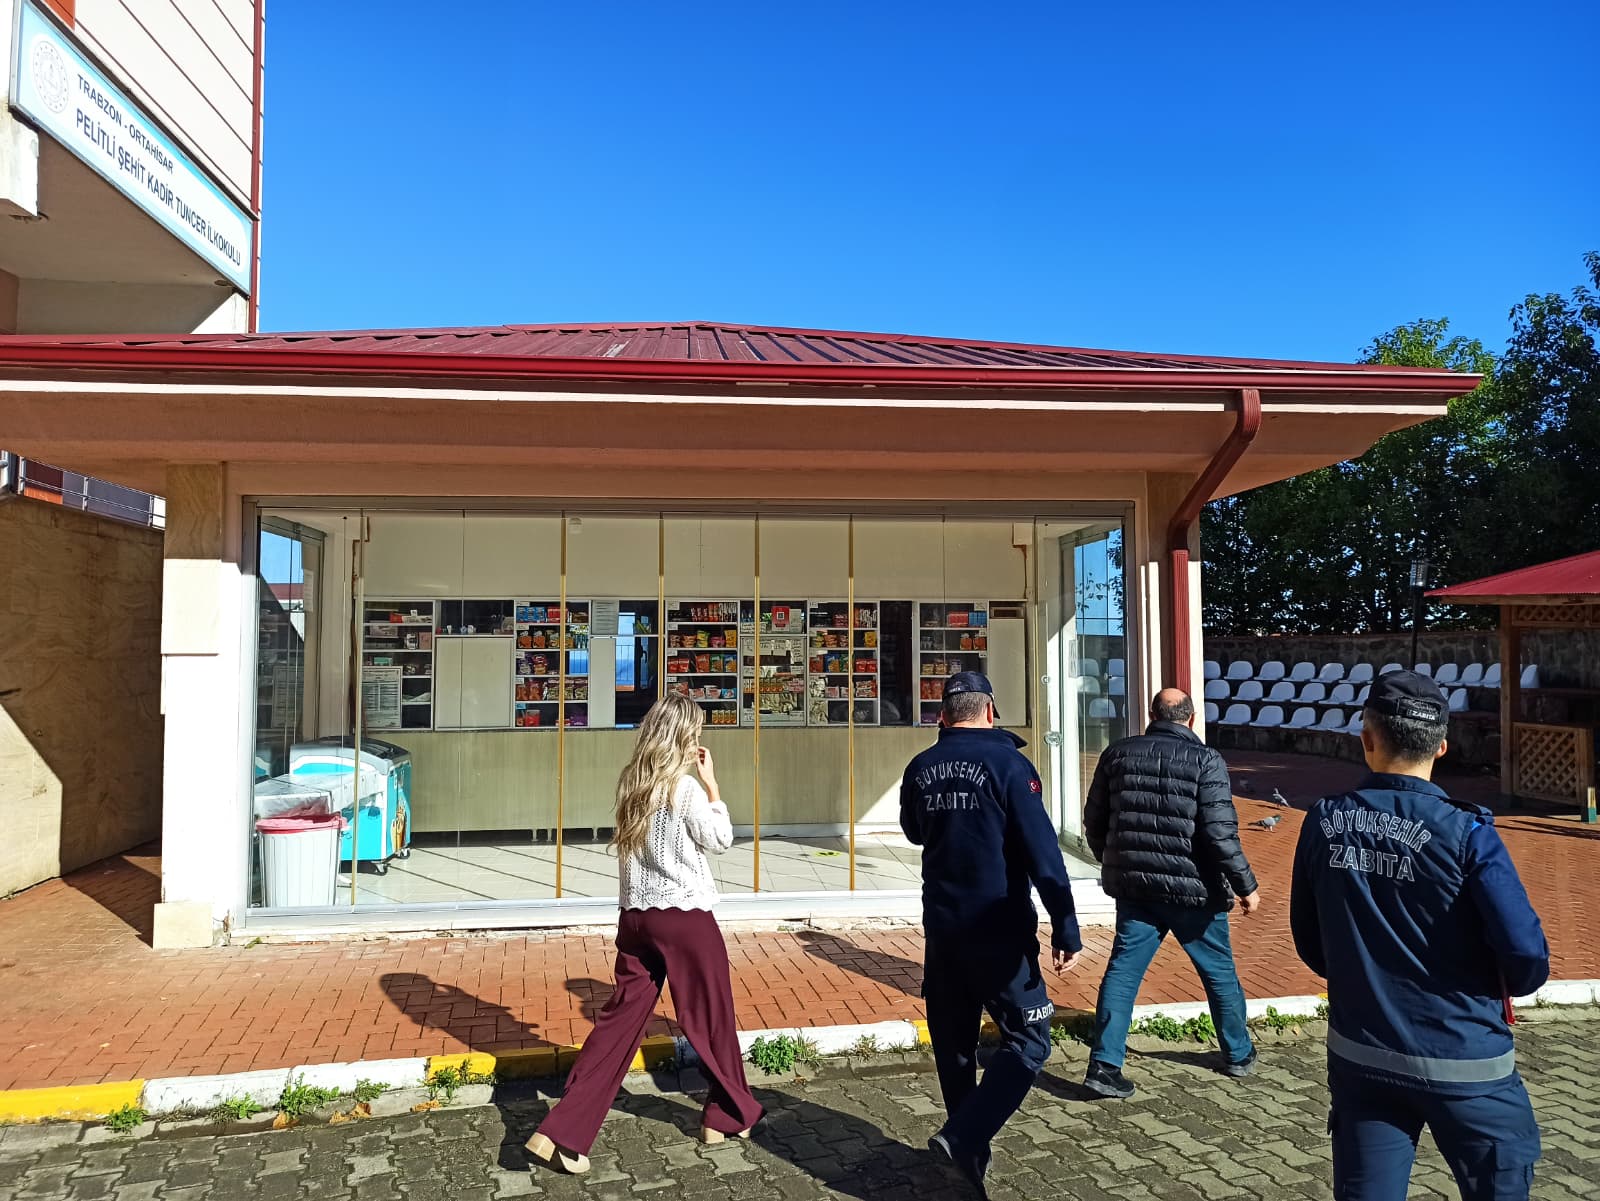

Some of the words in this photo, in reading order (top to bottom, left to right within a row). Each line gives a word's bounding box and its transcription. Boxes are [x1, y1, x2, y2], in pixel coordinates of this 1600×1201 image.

[78, 73, 122, 127] TRABZON
[129, 124, 174, 175] ORTAHİSAR
[76, 107, 116, 160] PELİTLİ
[118, 145, 146, 184] ŞEHİT
[147, 171, 174, 210] KADİR
[176, 196, 206, 238] TUNCER
[207, 220, 241, 267] İLKOKULU
[924, 791, 980, 812] ZABITA
[1319, 806, 1432, 853] BÜYÜKŞEHİR
[1329, 843, 1416, 882] ZABITA
